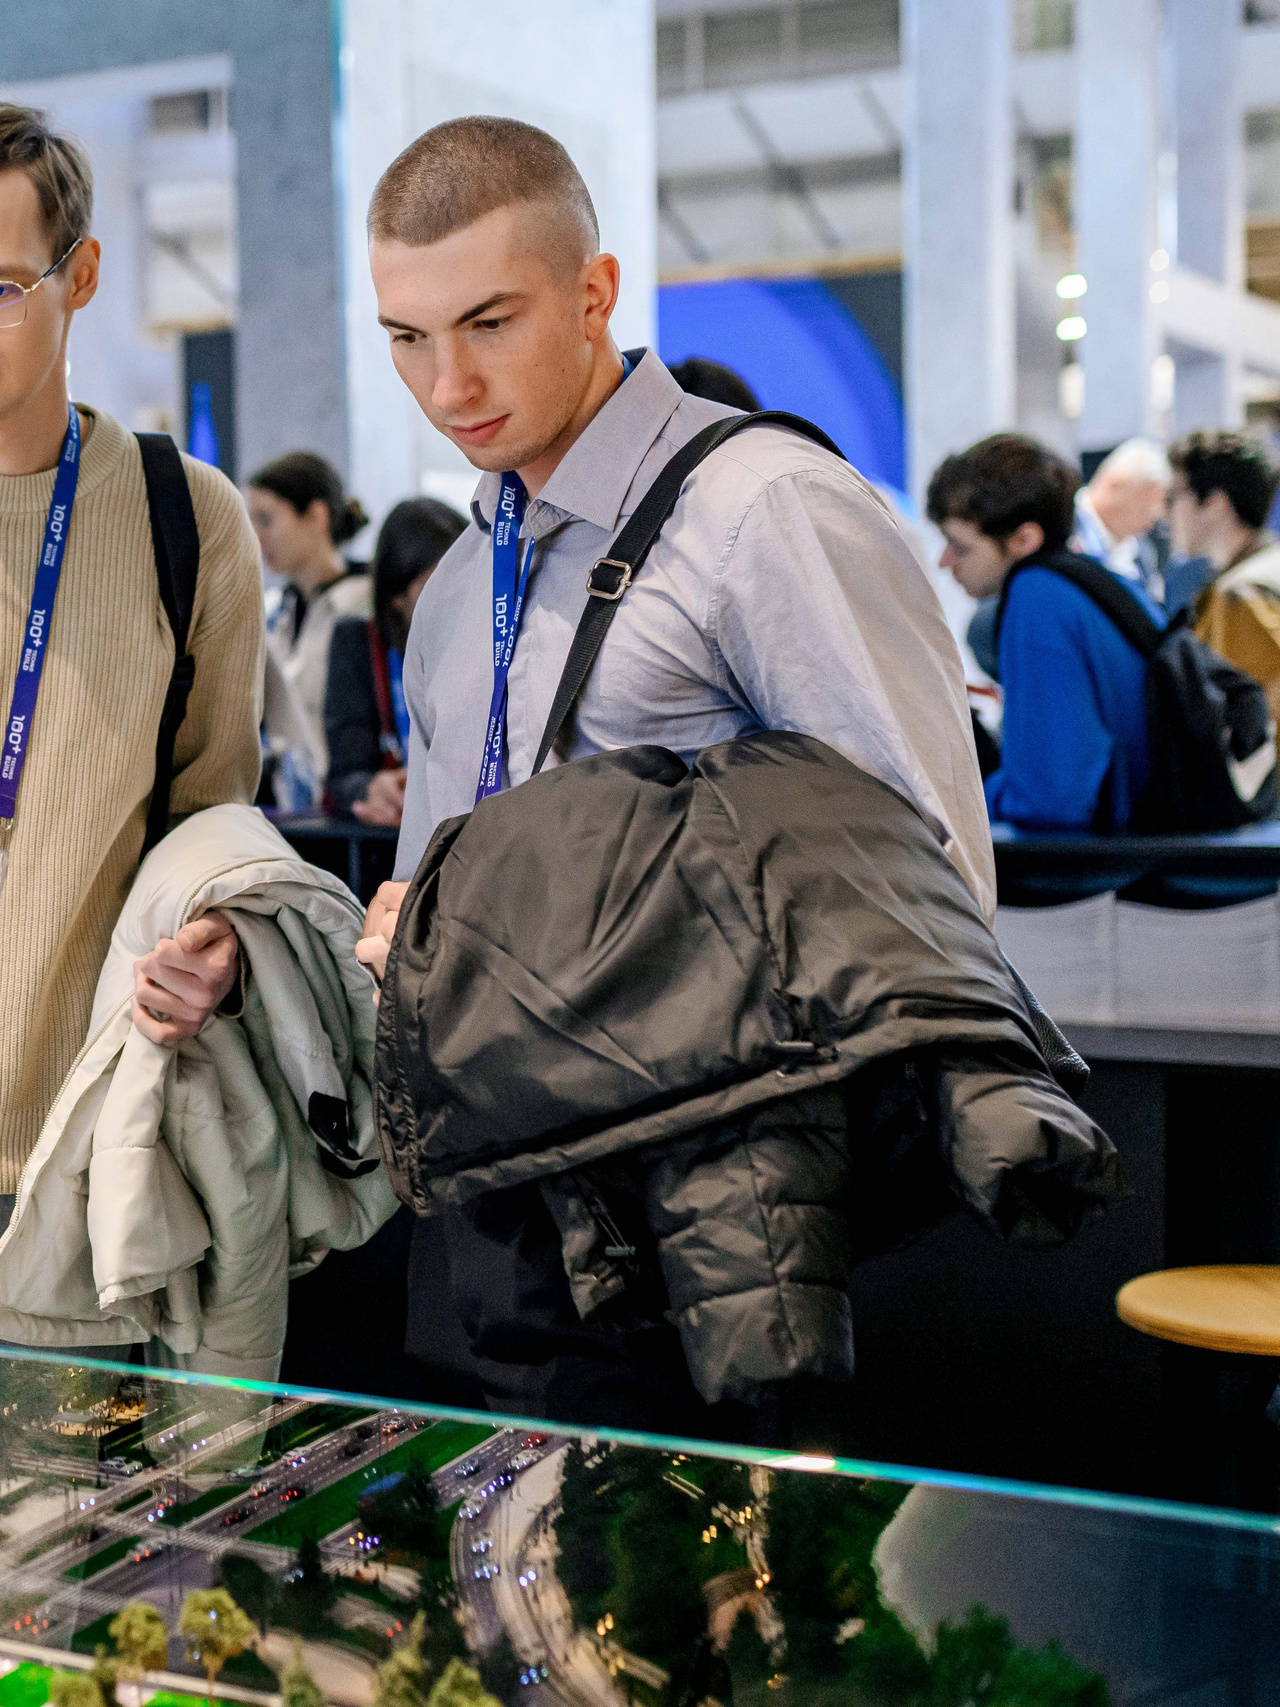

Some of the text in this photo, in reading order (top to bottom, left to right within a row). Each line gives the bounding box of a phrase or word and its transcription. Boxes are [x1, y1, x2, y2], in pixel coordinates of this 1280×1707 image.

[501, 486, 516, 520] 100+
[51, 504, 66, 542] 100+
[496, 521, 505, 546] BUILD
[43, 543, 53, 565] BUILD
[495, 593, 509, 637] 100+
[29, 609, 46, 648] 100+
[22, 648, 33, 671] BUILD
[28, 649, 38, 672] TECHNO
[9, 715, 26, 754] 100+
[2, 755, 12, 779] BUILD
[8, 757, 17, 780] TECHNO
[487, 762, 495, 788] BUILD
